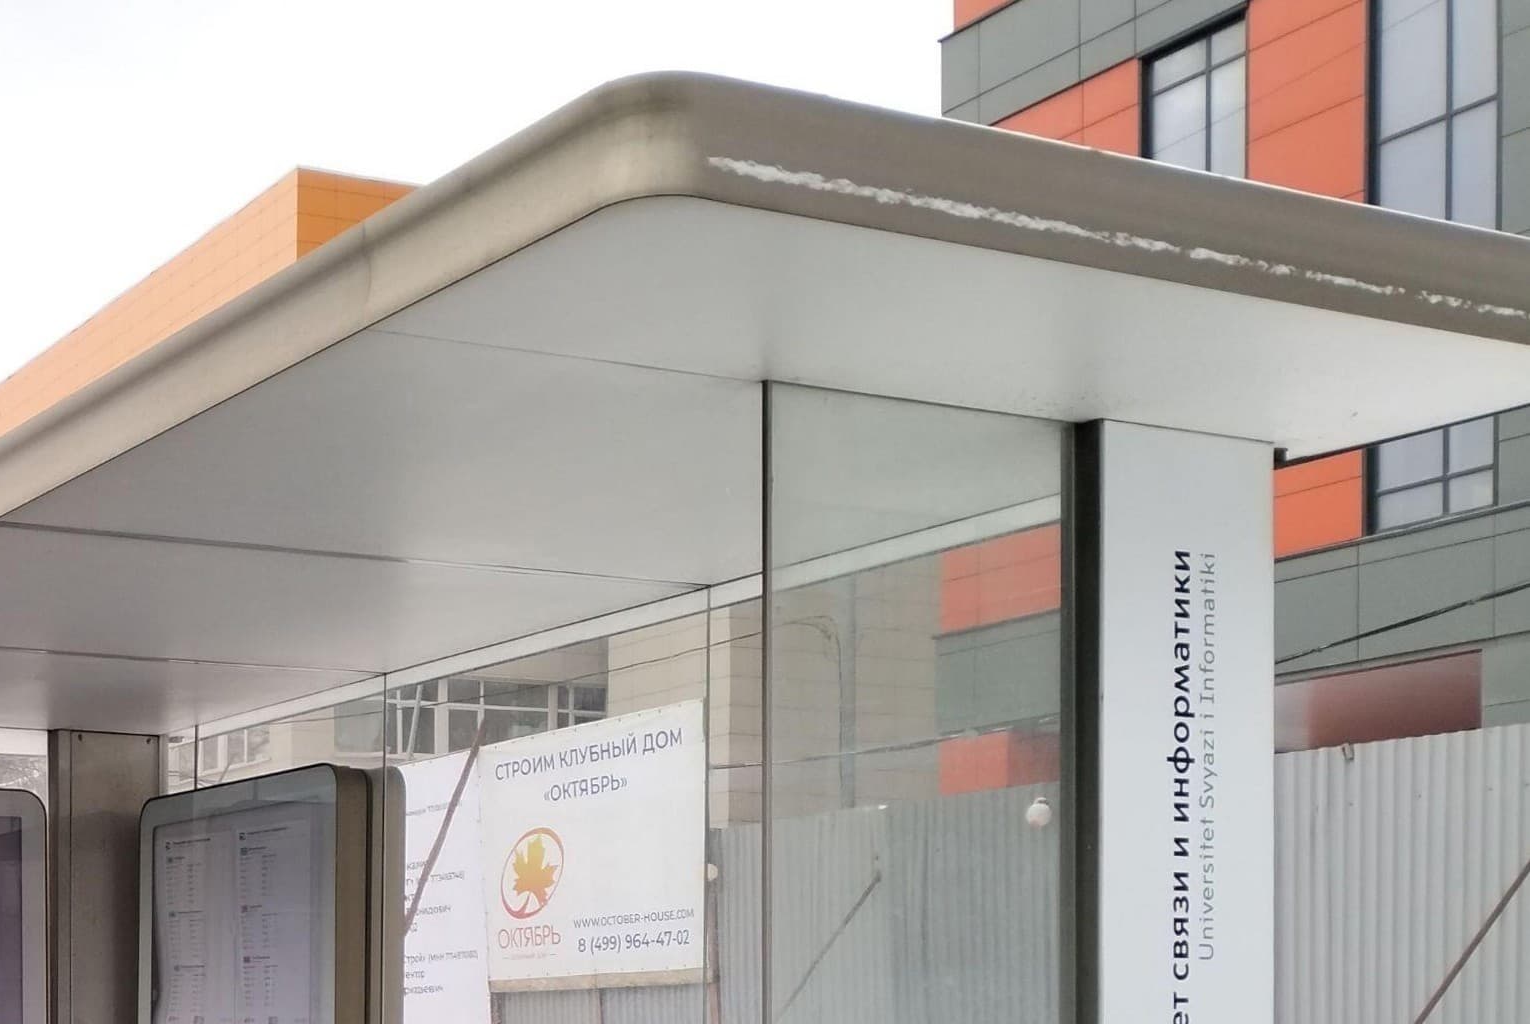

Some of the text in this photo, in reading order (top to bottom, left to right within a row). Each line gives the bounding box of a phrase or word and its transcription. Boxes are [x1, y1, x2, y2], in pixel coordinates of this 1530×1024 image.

[1198, 552, 1216, 704] Informatiki
[1166, 550, 1196, 823] информатики
[494, 727, 683, 781] СТРОИМ КЛУБНЫЙ ДОМ
[1198, 729, 1218, 809] Svyazi
[543, 773, 628, 801] «ОКТЯБРЬ»
[1172, 837, 1189, 857] и
[1198, 818, 1216, 960] Universitet
[497, 924, 561, 949] ОКТЯБРЬ
[573, 908, 695, 929] WWW.OCTOBER-HOUSE.COM
[577, 929, 691, 955] 8 (499) 964-47-02
[1172, 872, 1190, 981] связи
